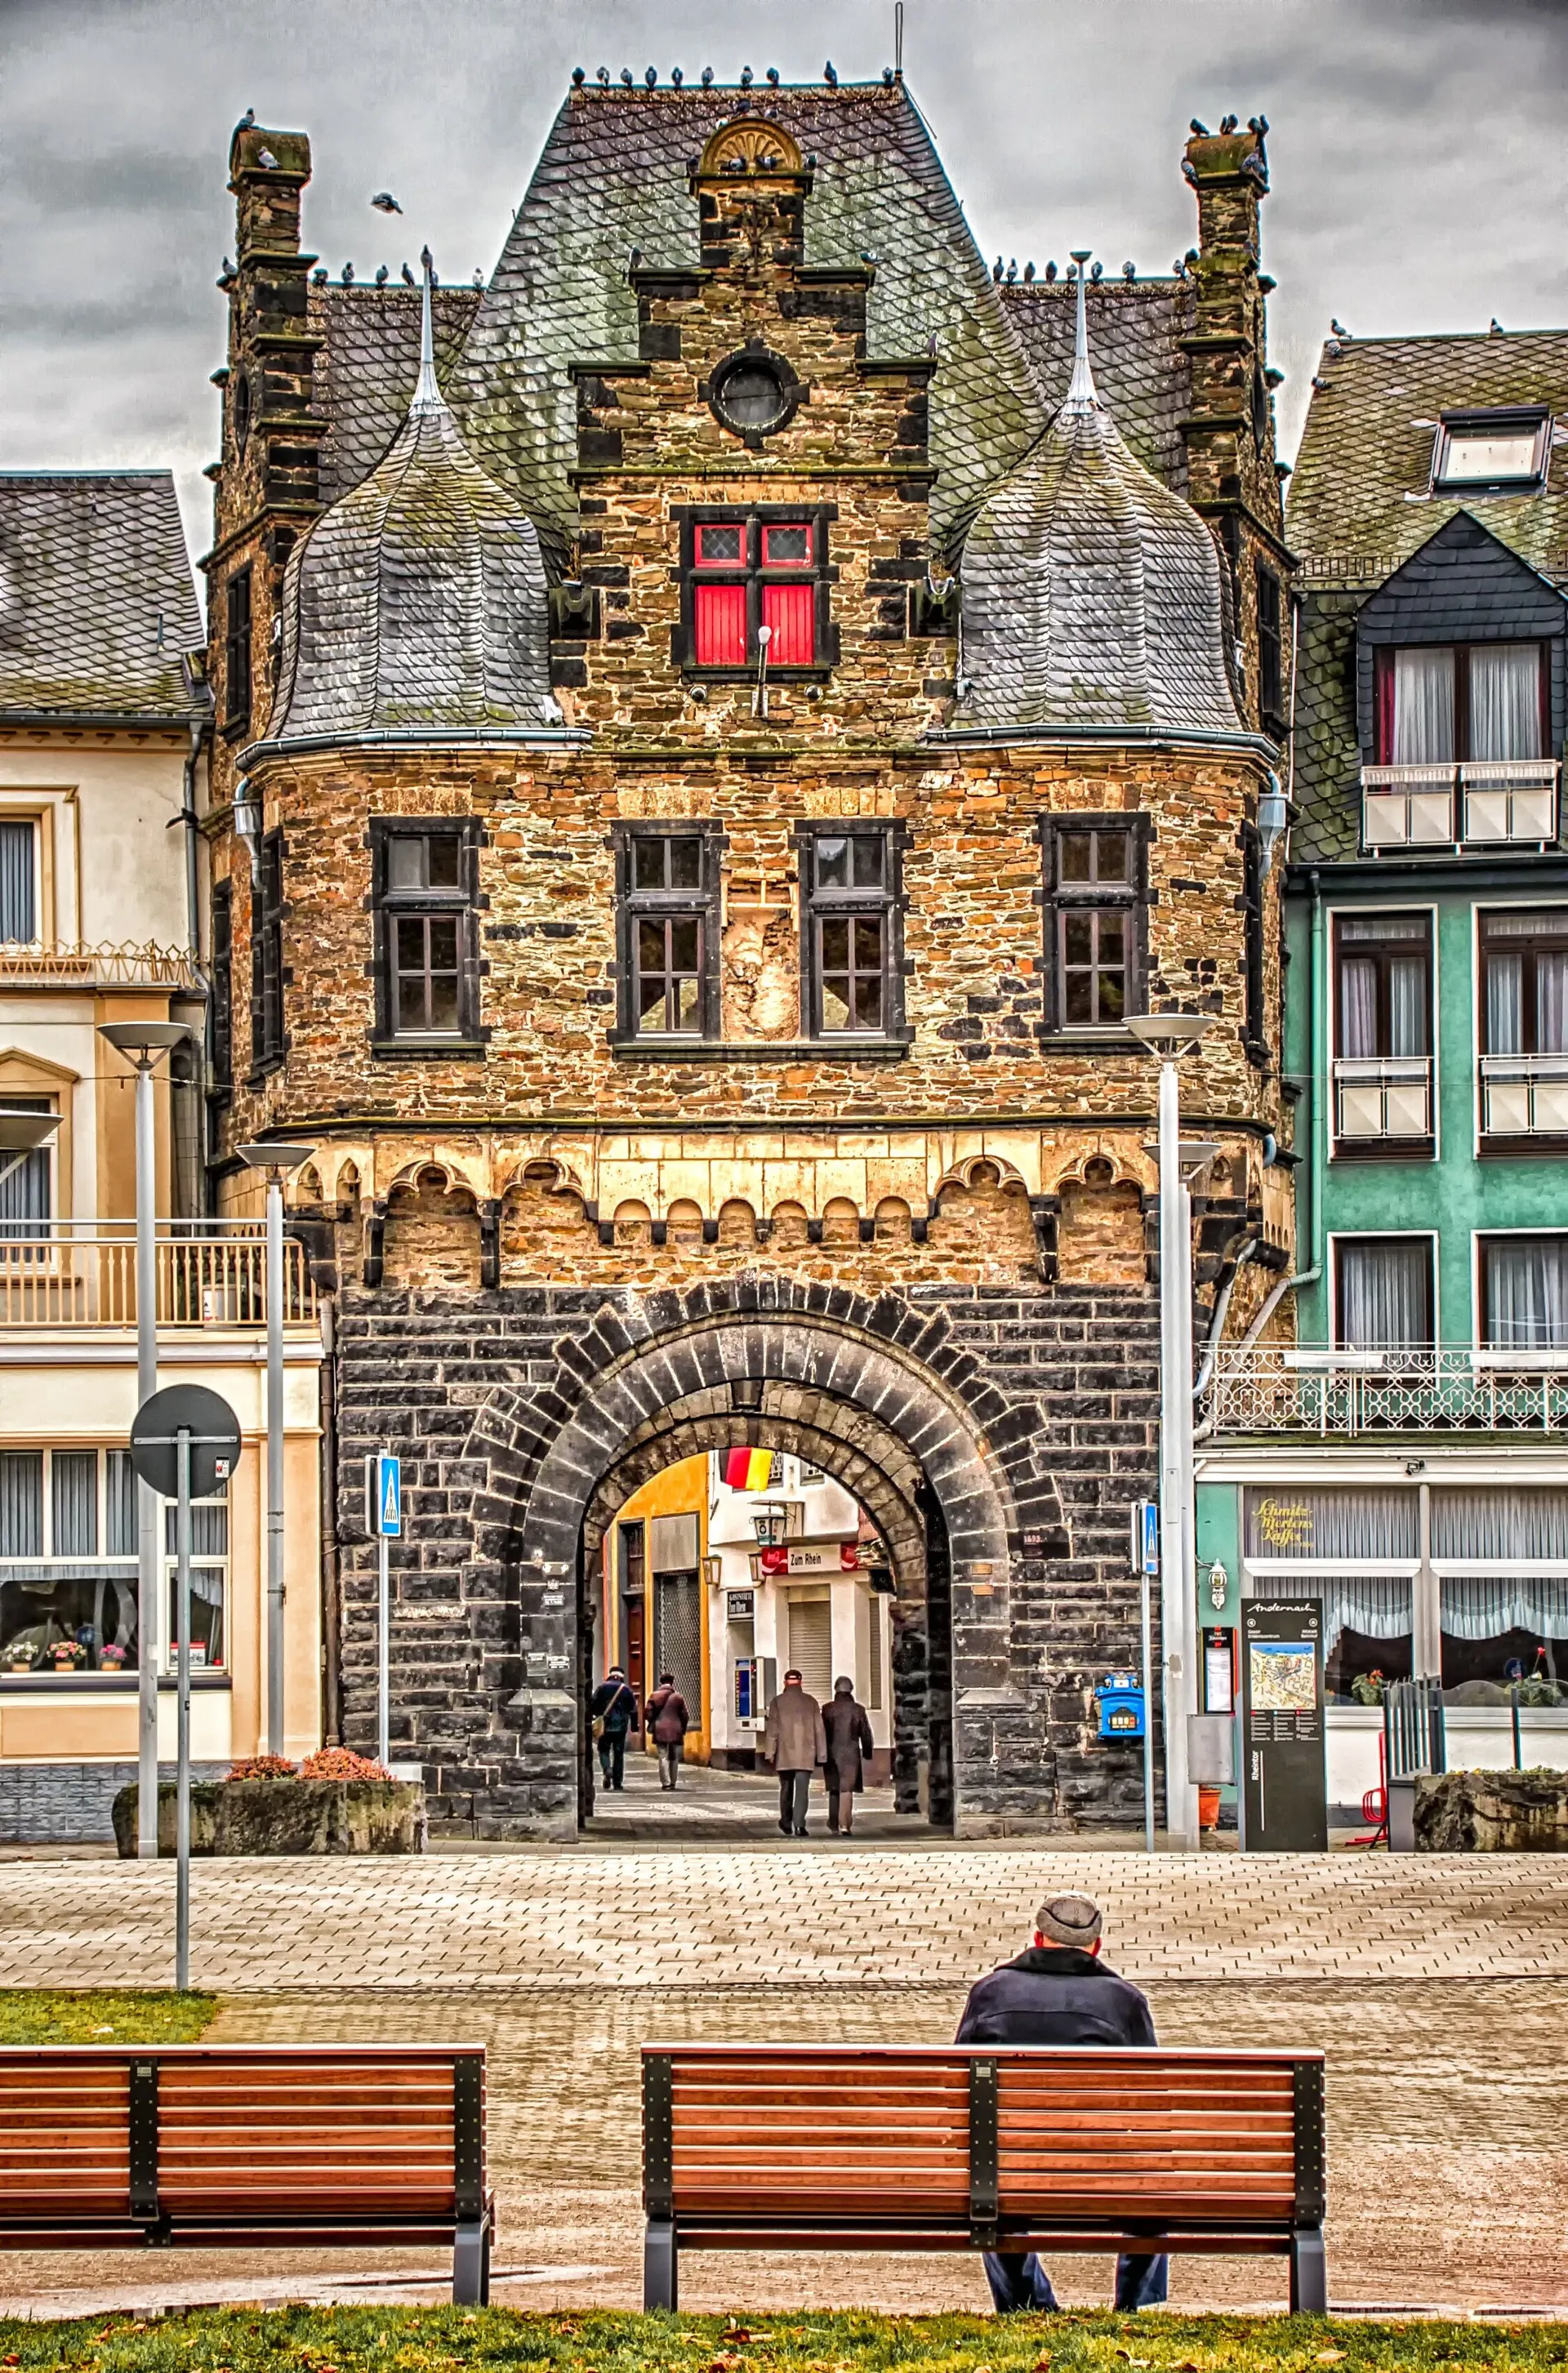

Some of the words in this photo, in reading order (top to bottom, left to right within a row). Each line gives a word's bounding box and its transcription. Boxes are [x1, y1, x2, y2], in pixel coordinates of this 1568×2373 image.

[1256, 1516, 1313, 1530] Mertens
[791, 1554, 804, 1565] Zum
[804, 1553, 822, 1565] Rhein
[1247, 1602, 1316, 1613] Andernach
[1250, 1750, 1259, 1781] Rheintor
